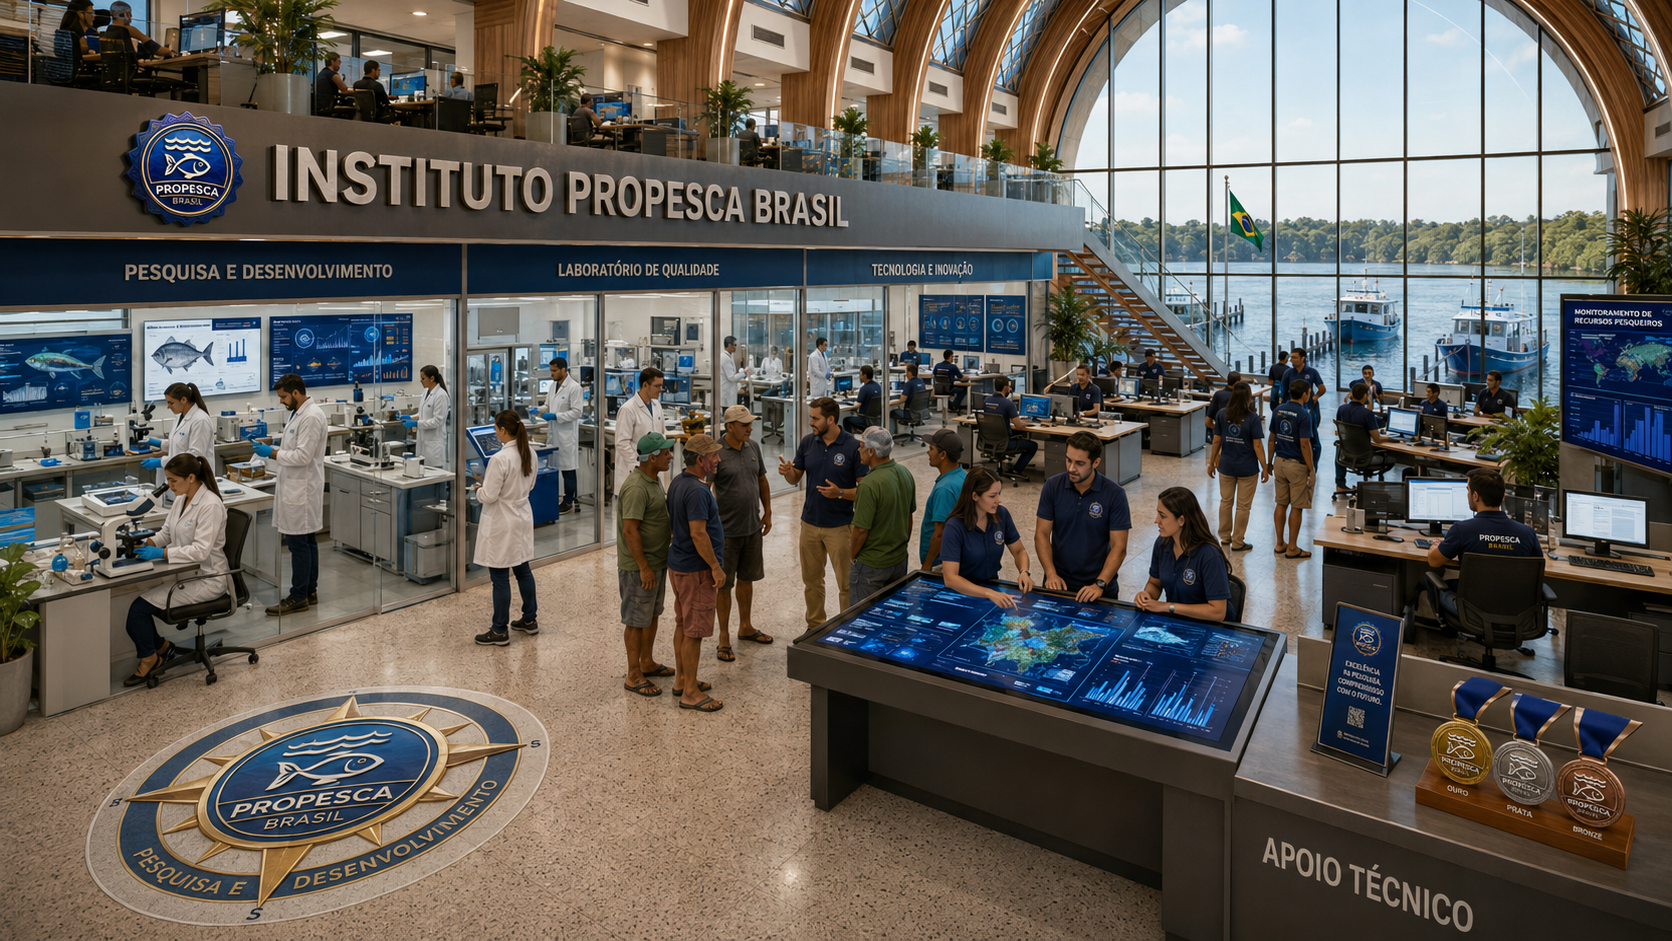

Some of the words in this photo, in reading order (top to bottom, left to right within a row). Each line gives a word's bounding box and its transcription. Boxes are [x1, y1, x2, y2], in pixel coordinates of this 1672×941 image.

[156, 184, 219, 197] PROPESCA
[271, 144, 553, 213] INSTITUTO
[566, 171, 745, 222] PROPESCA
[753, 188, 849, 228] BRASIL
[173, 197, 202, 205] BRASIL
[124, 264, 221, 283] PESQUISA
[226, 264, 237, 280] E
[242, 264, 393, 280] DESENVOLVIMENTO
[558, 260, 642, 277] LABORATÓRIO
[645, 264, 660, 276] DE
[662, 264, 720, 278] QUALIDADE
[871, 263, 926, 276] TECNOLOGIA
[928, 263, 933, 276] E
[935, 261, 973, 278] INOVAÇÃO
[1574, 308, 1640, 318] MONITORAMENTO
[1641, 310, 1652, 318] DE
[1574, 317, 1613, 326] RECURSOS
[1614, 318, 1663, 328] PESQUEIROS
[1479, 534, 1520, 543] PROPESCA
[530, 739, 541, 748] S
[1446, 784, 1469, 797] OURO
[230, 785, 393, 818] PROPESCA
[1506, 804, 1533, 818] PRATA
[263, 810, 344, 831] BRASIL
[133, 847, 222, 895] PESQUISA
[228, 881, 248, 895] E
[292, 779, 499, 890] DESENVOLVIMENTO
[1262, 837, 1342, 887] APOIO
[1348, 863, 1474, 933] TÉCNICO
[246, 907, 264, 921] S
